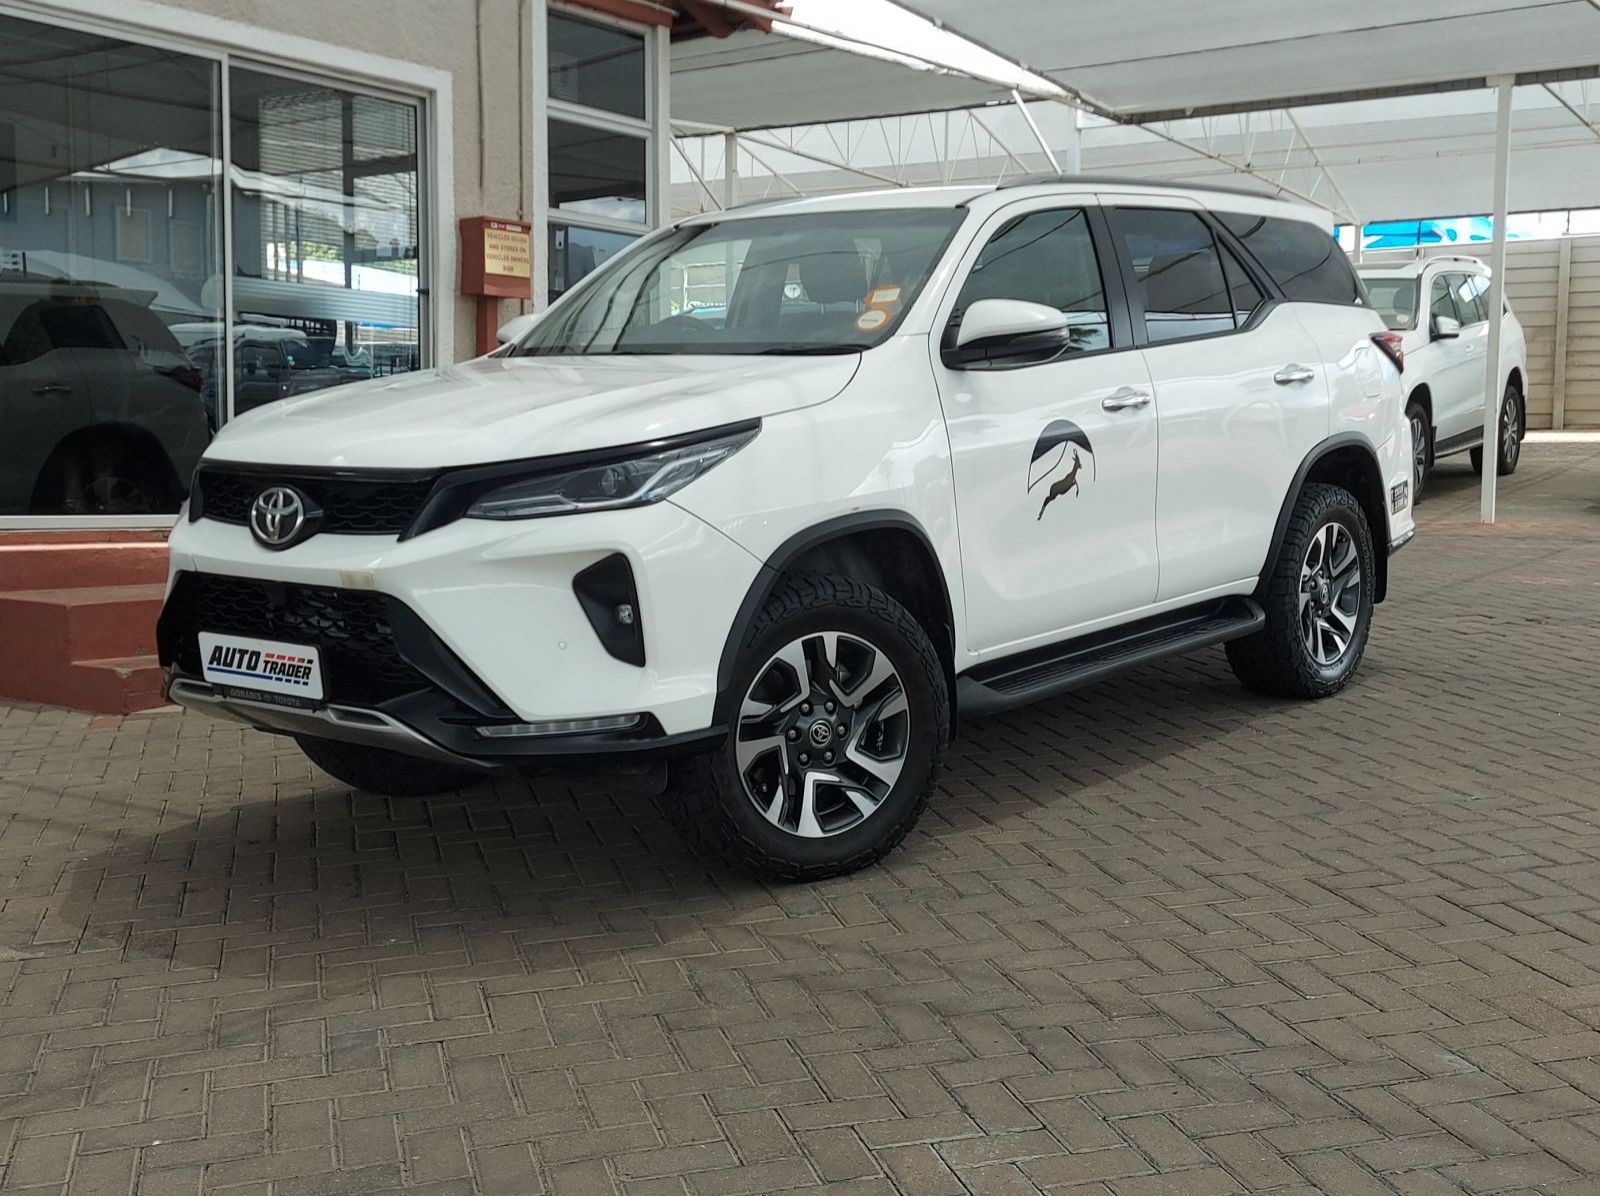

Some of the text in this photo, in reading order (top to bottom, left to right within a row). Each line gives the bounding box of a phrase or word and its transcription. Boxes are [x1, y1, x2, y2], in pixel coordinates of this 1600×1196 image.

[208, 645, 312, 680] AUTO TRADER
[274, 695, 301, 707] TOYOTA
